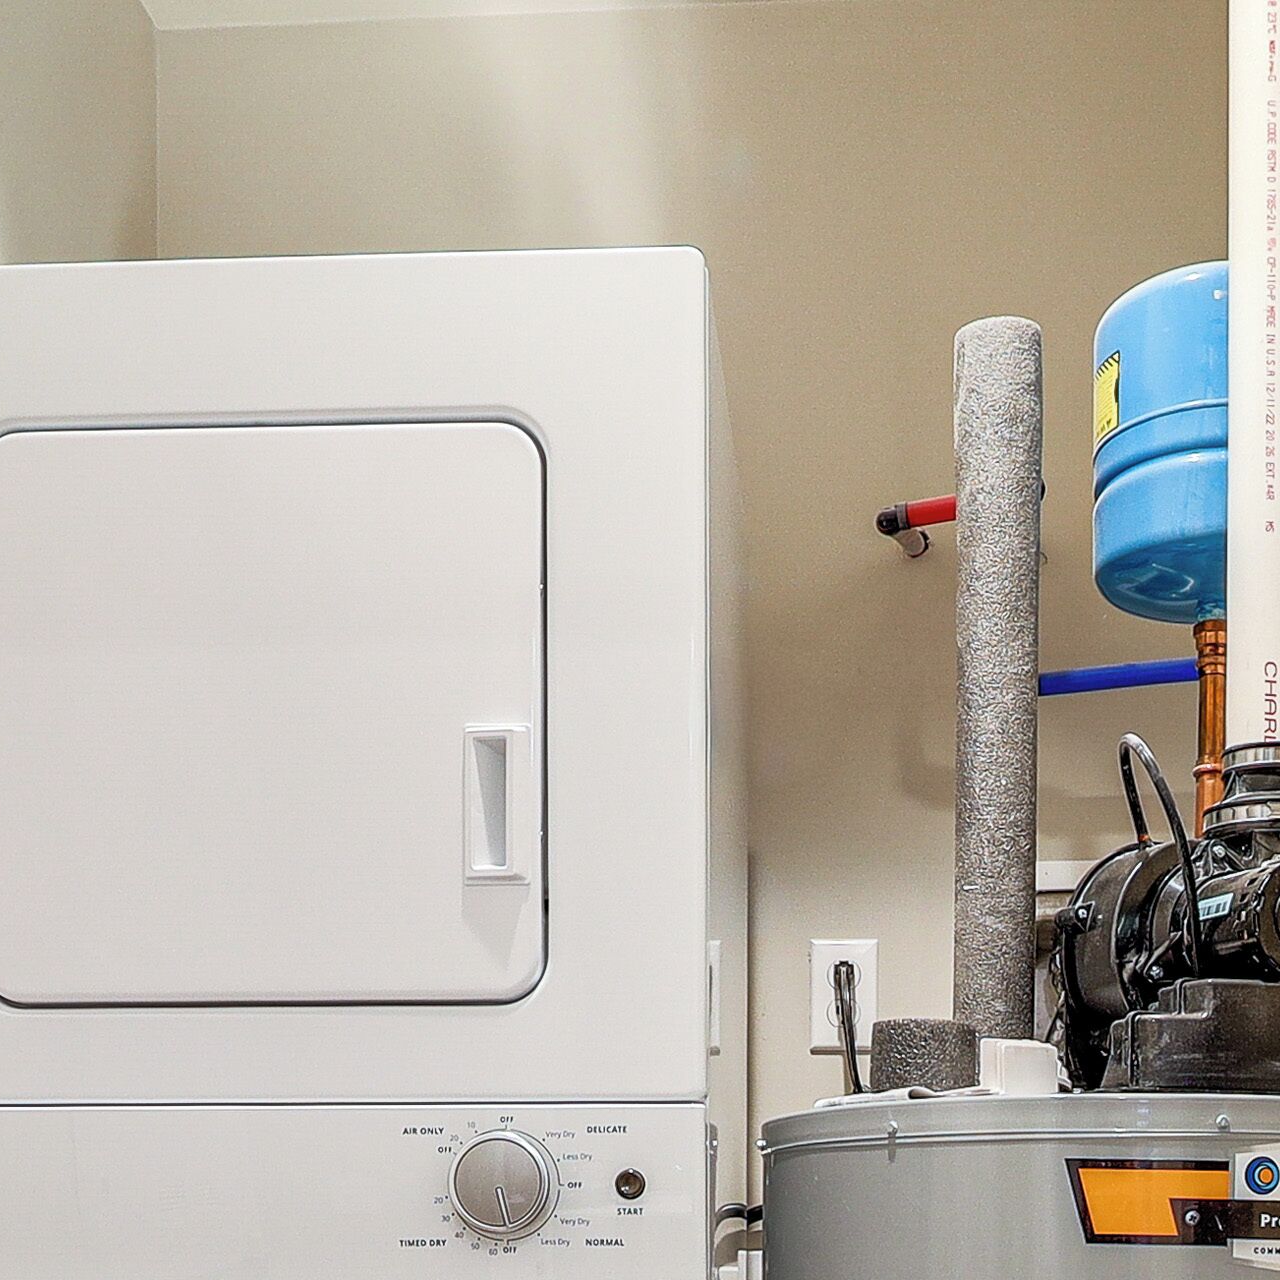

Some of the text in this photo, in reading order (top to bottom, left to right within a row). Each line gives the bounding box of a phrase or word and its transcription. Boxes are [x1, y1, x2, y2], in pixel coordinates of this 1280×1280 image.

[1266, 305, 1276, 328] MADE
[1266, 334, 1276, 345] IN
[1264, 661, 1277, 743] CHARL
[546, 1131, 576, 1139] Very Dry
[580, 1153, 592, 1161] Dry
[560, 1218, 590, 1226] Very Dry
[558, 1239, 570, 1247] Dry
